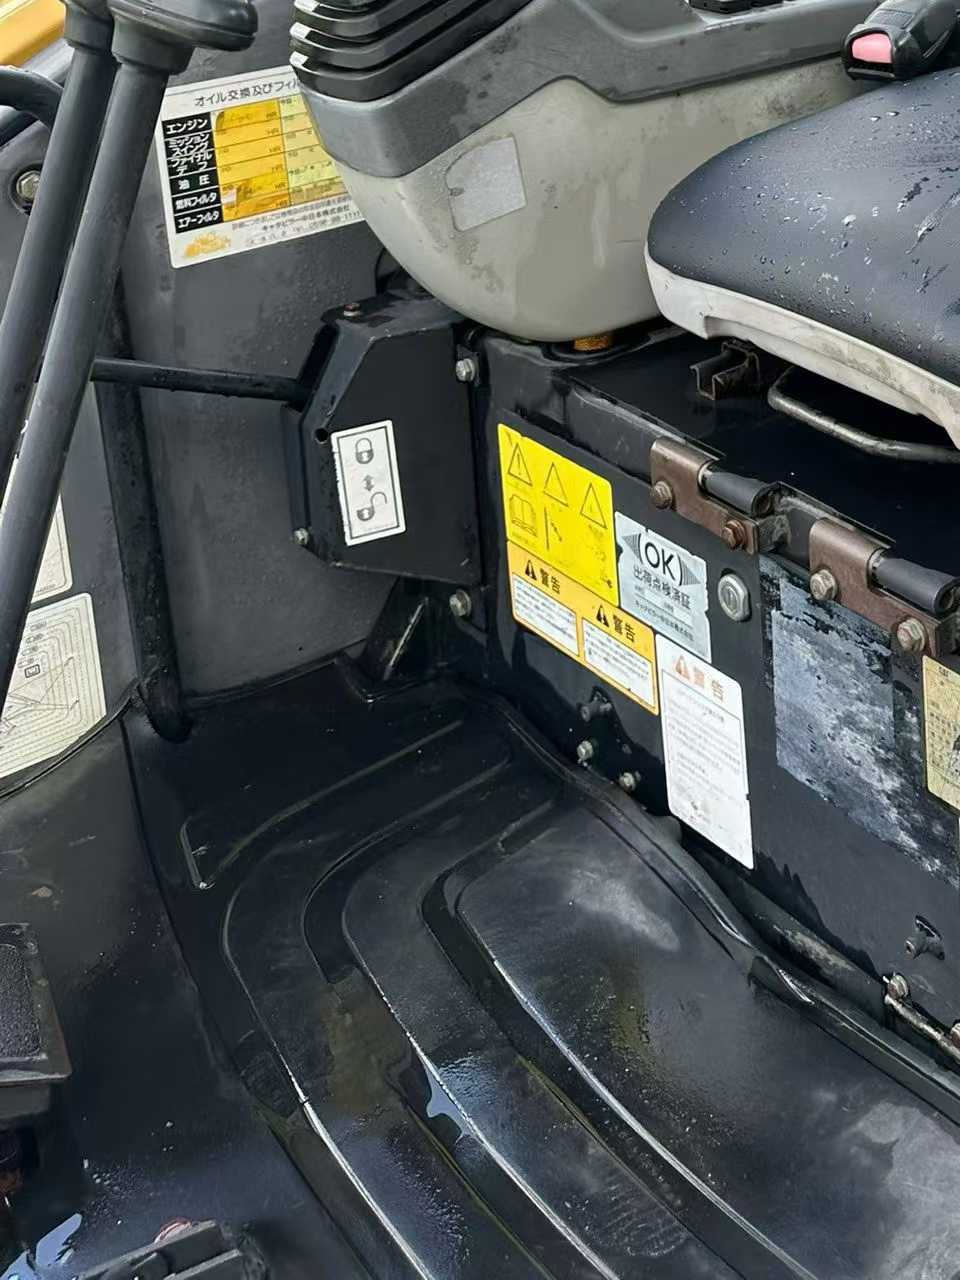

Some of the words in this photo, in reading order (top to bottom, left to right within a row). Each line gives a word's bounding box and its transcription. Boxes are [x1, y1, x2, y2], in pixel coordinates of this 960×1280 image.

[166, 119, 208, 135] エンジン
[540, 567, 561, 595] 警告
[612, 614, 636, 643] 警告
